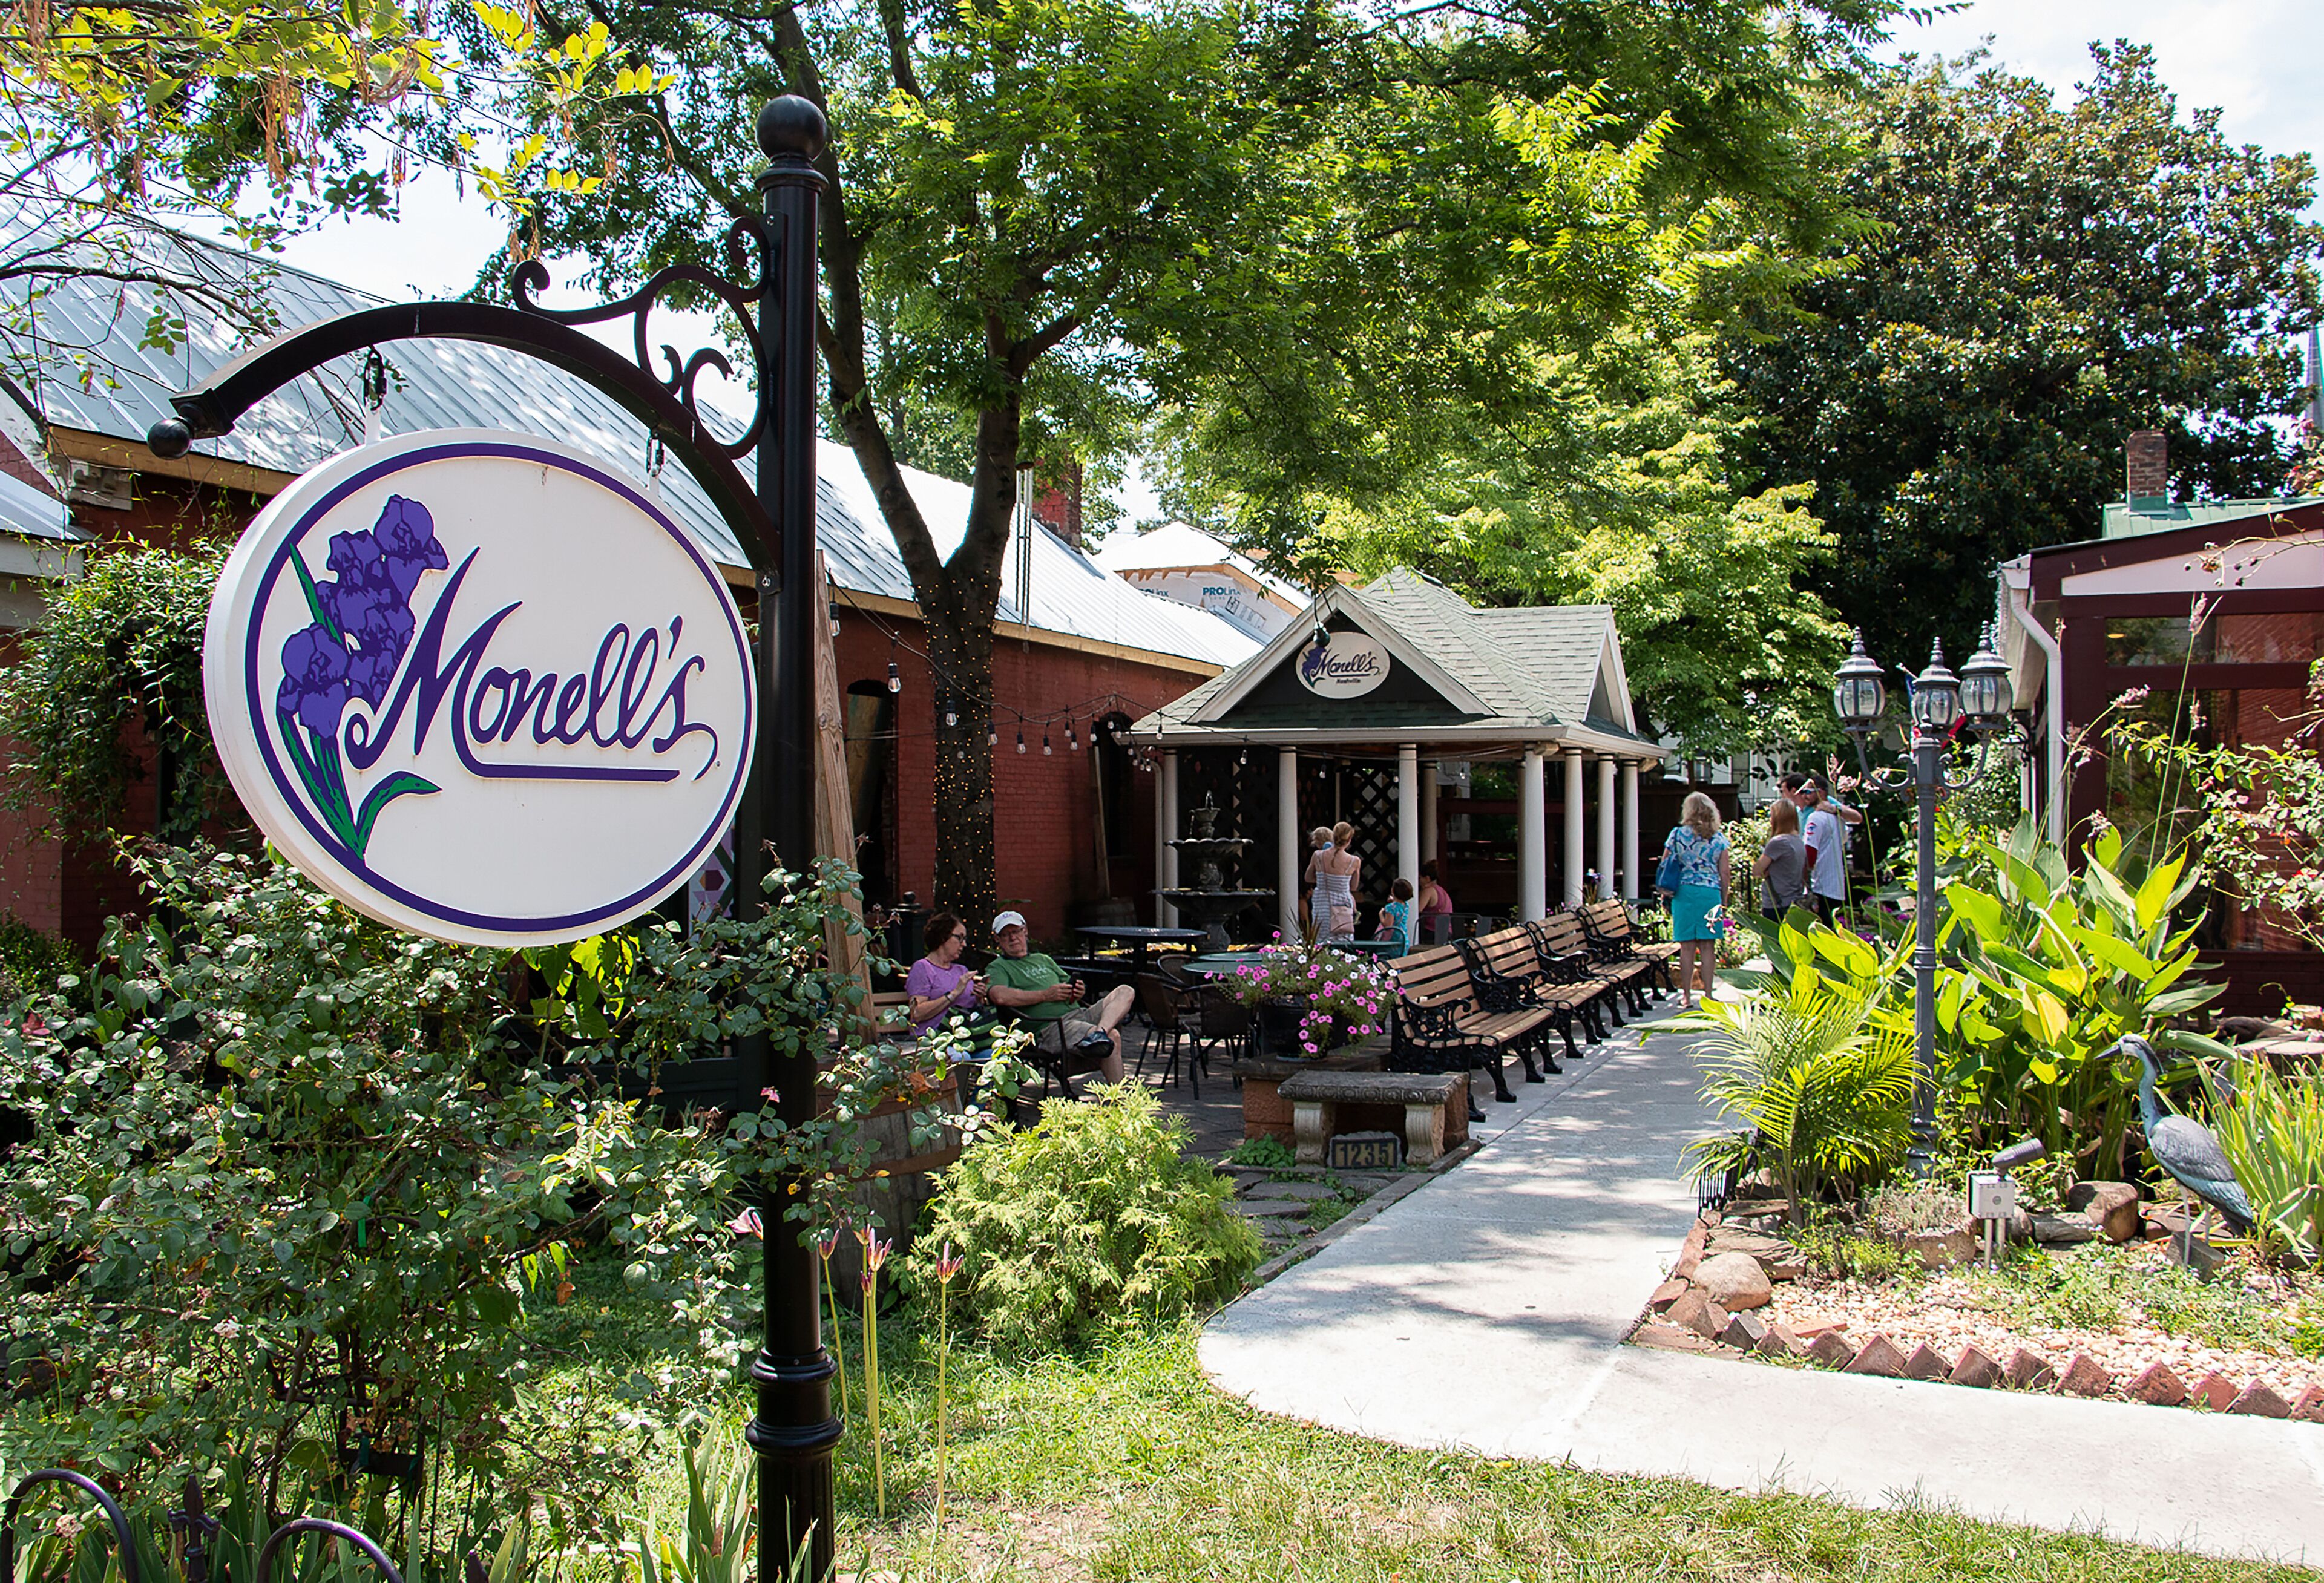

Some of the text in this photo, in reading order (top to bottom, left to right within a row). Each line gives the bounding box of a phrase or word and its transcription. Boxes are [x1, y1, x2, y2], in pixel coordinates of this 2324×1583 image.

[344, 546, 718, 782] Monell's
[1309, 648, 1379, 677] Monell's
[1339, 1142, 1389, 1165] 1235
